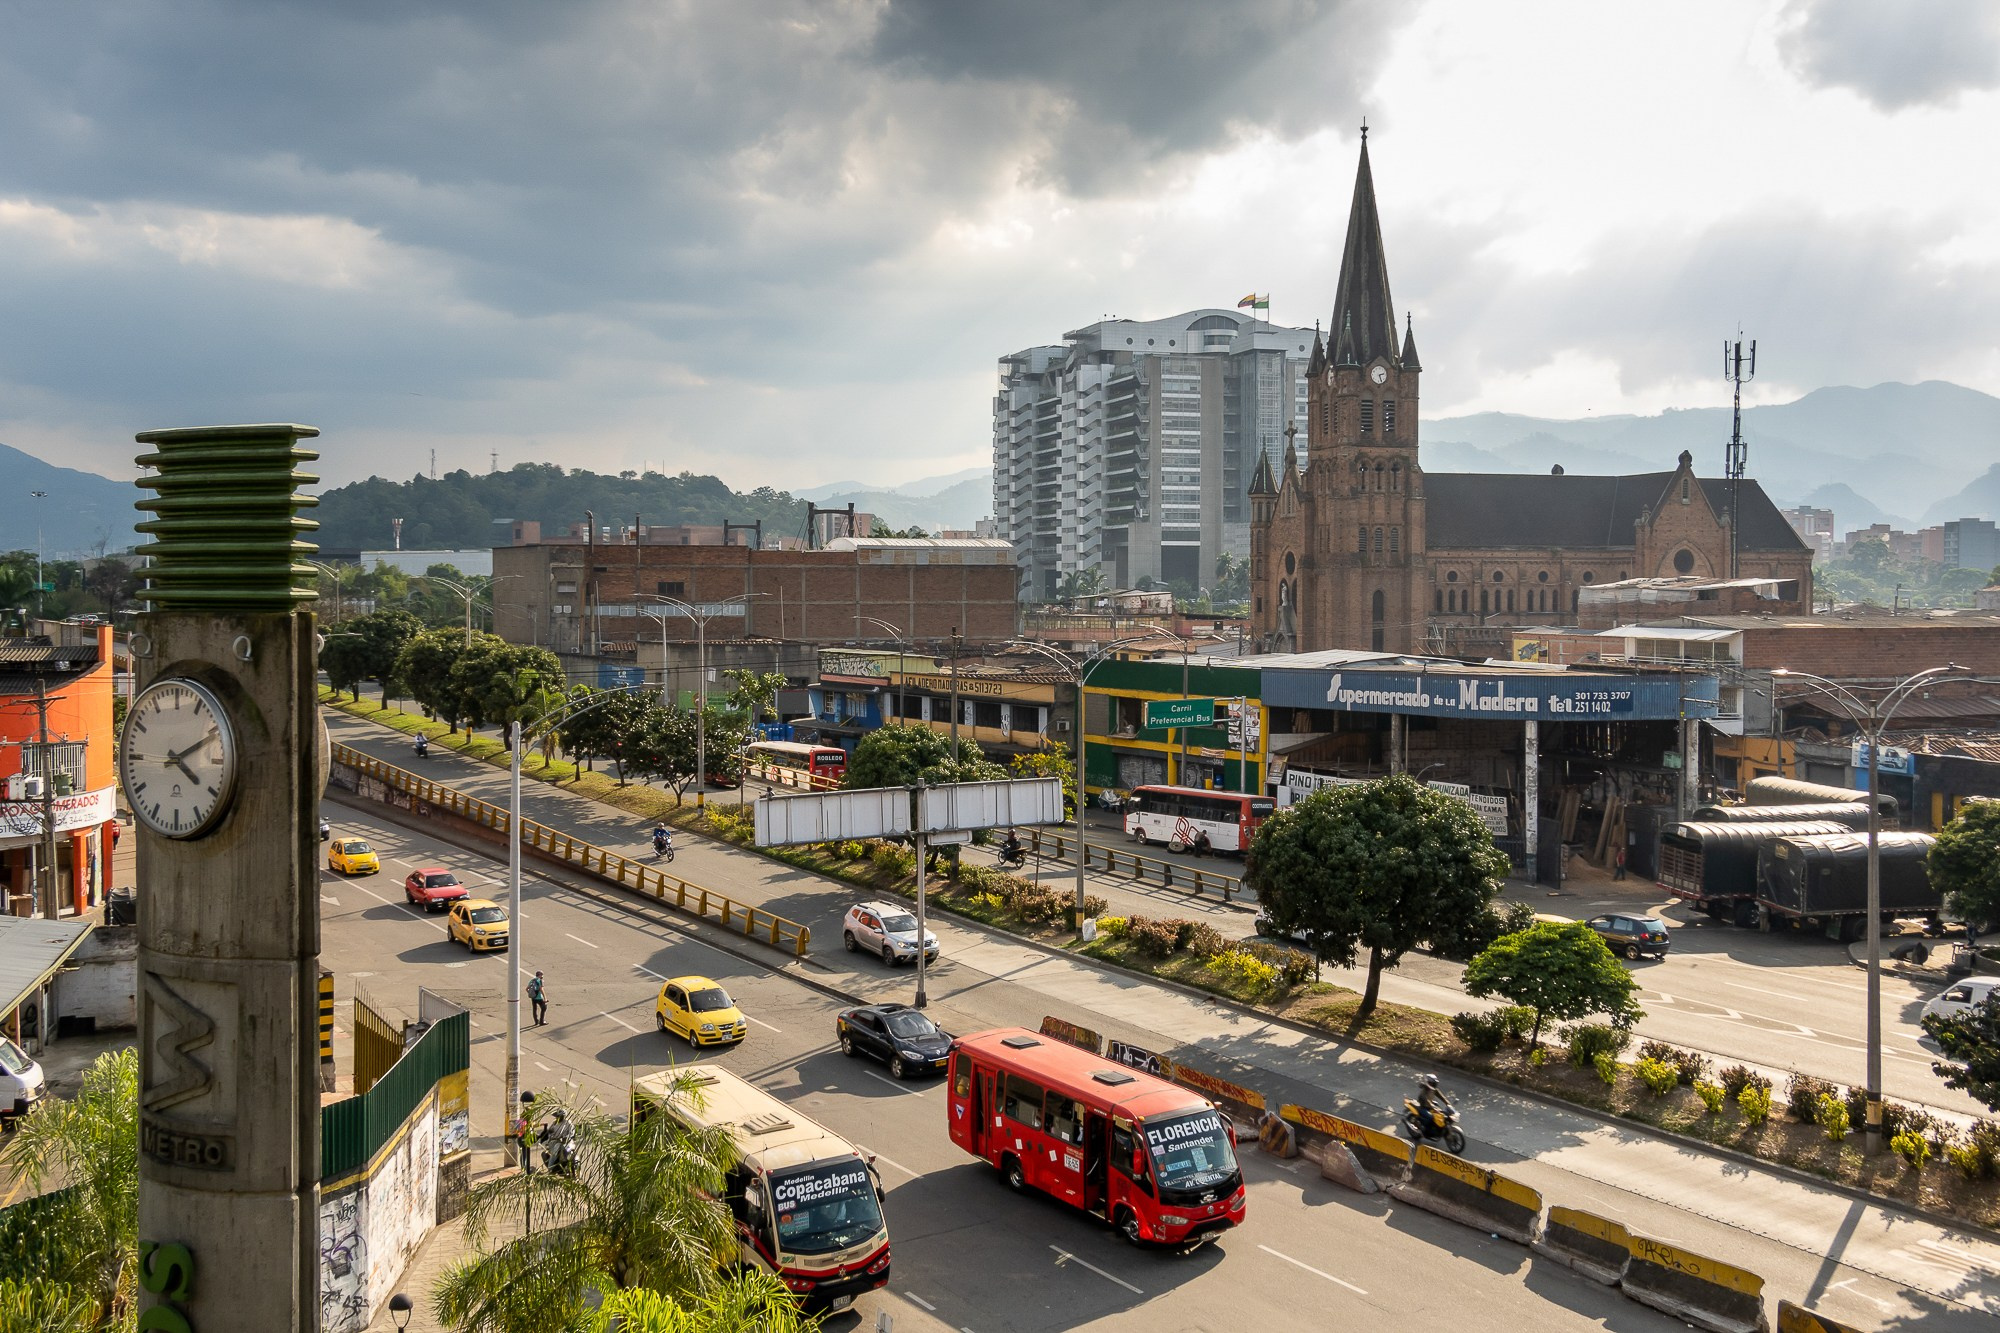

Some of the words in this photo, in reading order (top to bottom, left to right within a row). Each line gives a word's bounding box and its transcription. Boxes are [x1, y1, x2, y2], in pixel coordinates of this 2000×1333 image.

[1327, 673, 1430, 711] Supermercado
[1433, 694, 1444, 706] de
[1458, 679, 1539, 712] Madera
[1575, 692, 1591, 700] 301
[1592, 691, 1608, 700] 733
[1610, 691, 1631, 700] 3707
[1171, 704, 1192, 713] Carril
[1575, 701, 1589, 713] 251
[1150, 716, 1194, 725] Preferencial
[1196, 714, 1211, 722] Bus
[1288, 773, 1312, 789] PINO
[1471, 793, 1505, 805] TENDIDOS
[1483, 805, 1503, 814] CAMA
[1147, 1116, 1222, 1145] FLORENCIA
[143, 1122, 223, 1165] METRO
[1168, 1135, 1214, 1153] Santander
[775, 1171, 866, 1200] Copacabana
[783, 1174, 815, 1186] Medellin
[800, 1186, 849, 1203] Medellin
[778, 1200, 796, 1212] BUS
